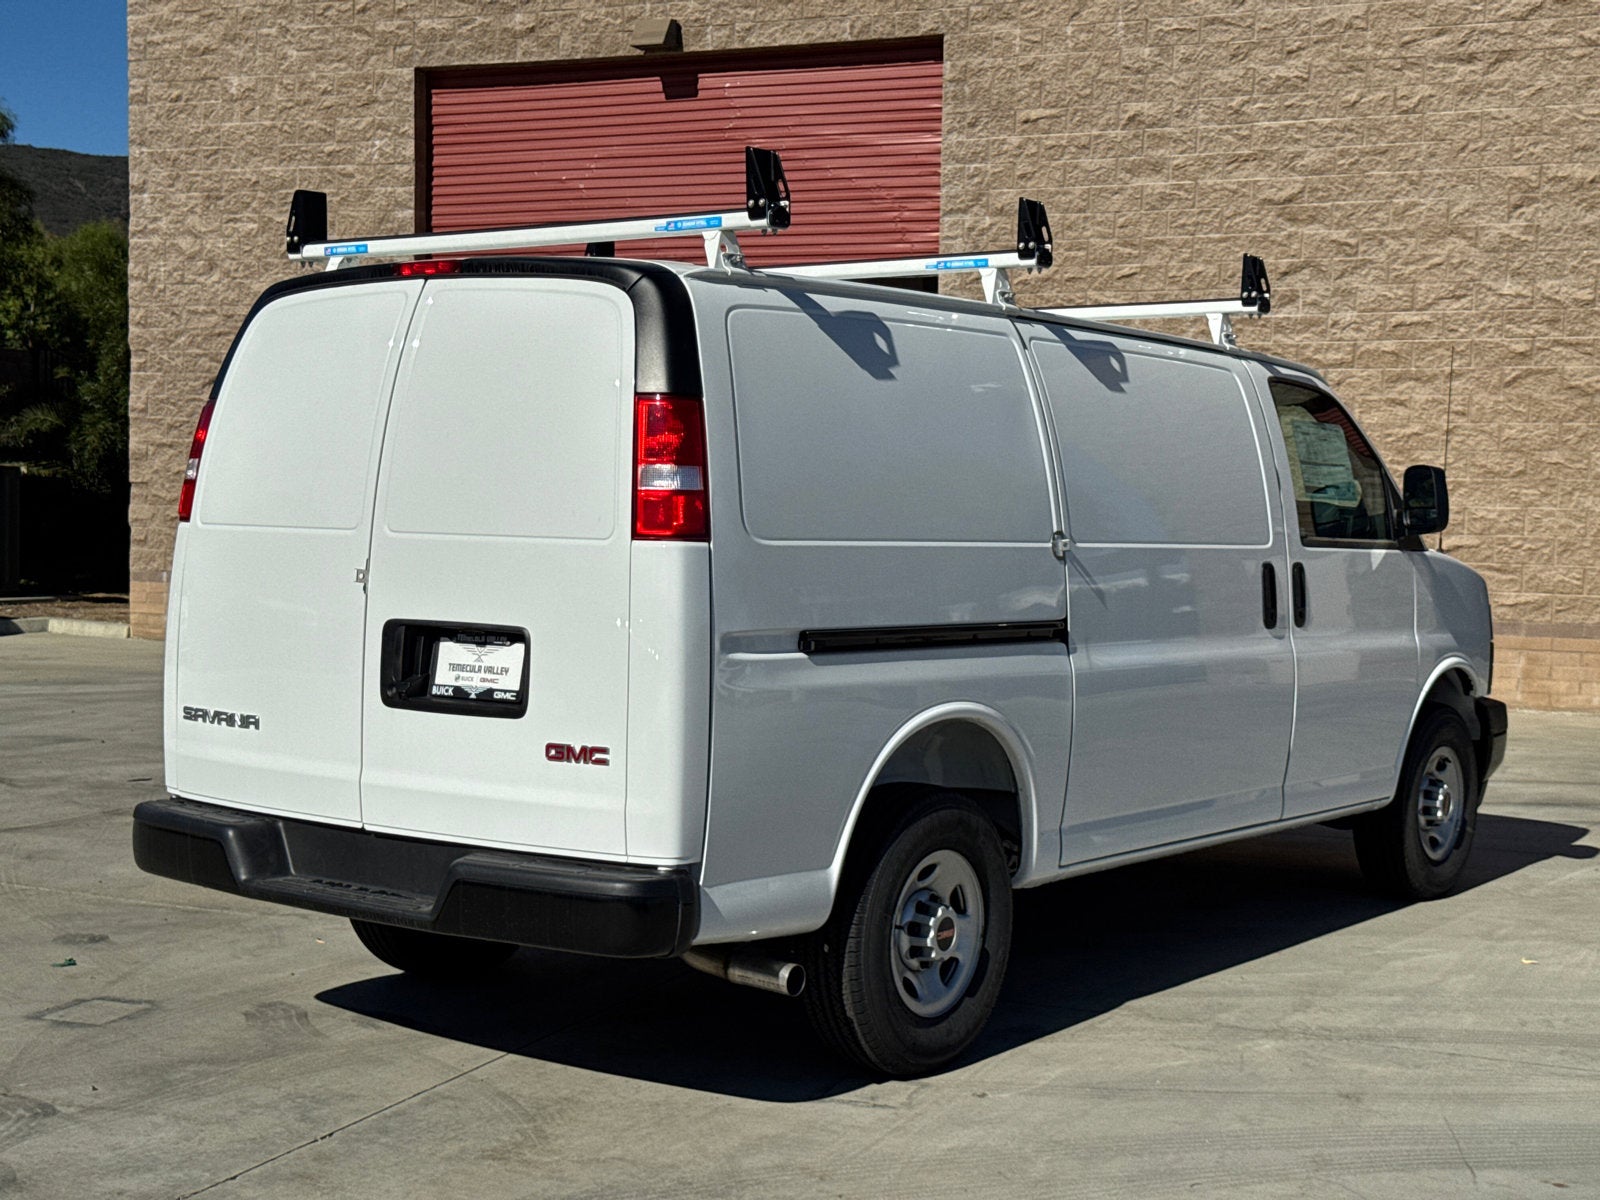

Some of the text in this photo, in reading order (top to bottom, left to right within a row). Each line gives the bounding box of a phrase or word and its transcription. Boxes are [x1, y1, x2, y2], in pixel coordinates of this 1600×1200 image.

[448, 663, 510, 676] TEMECULA VALLEY
[431, 685, 517, 700] BUICK GMC
[183, 706, 260, 730] SAVANA
[545, 742, 610, 766] GMC
